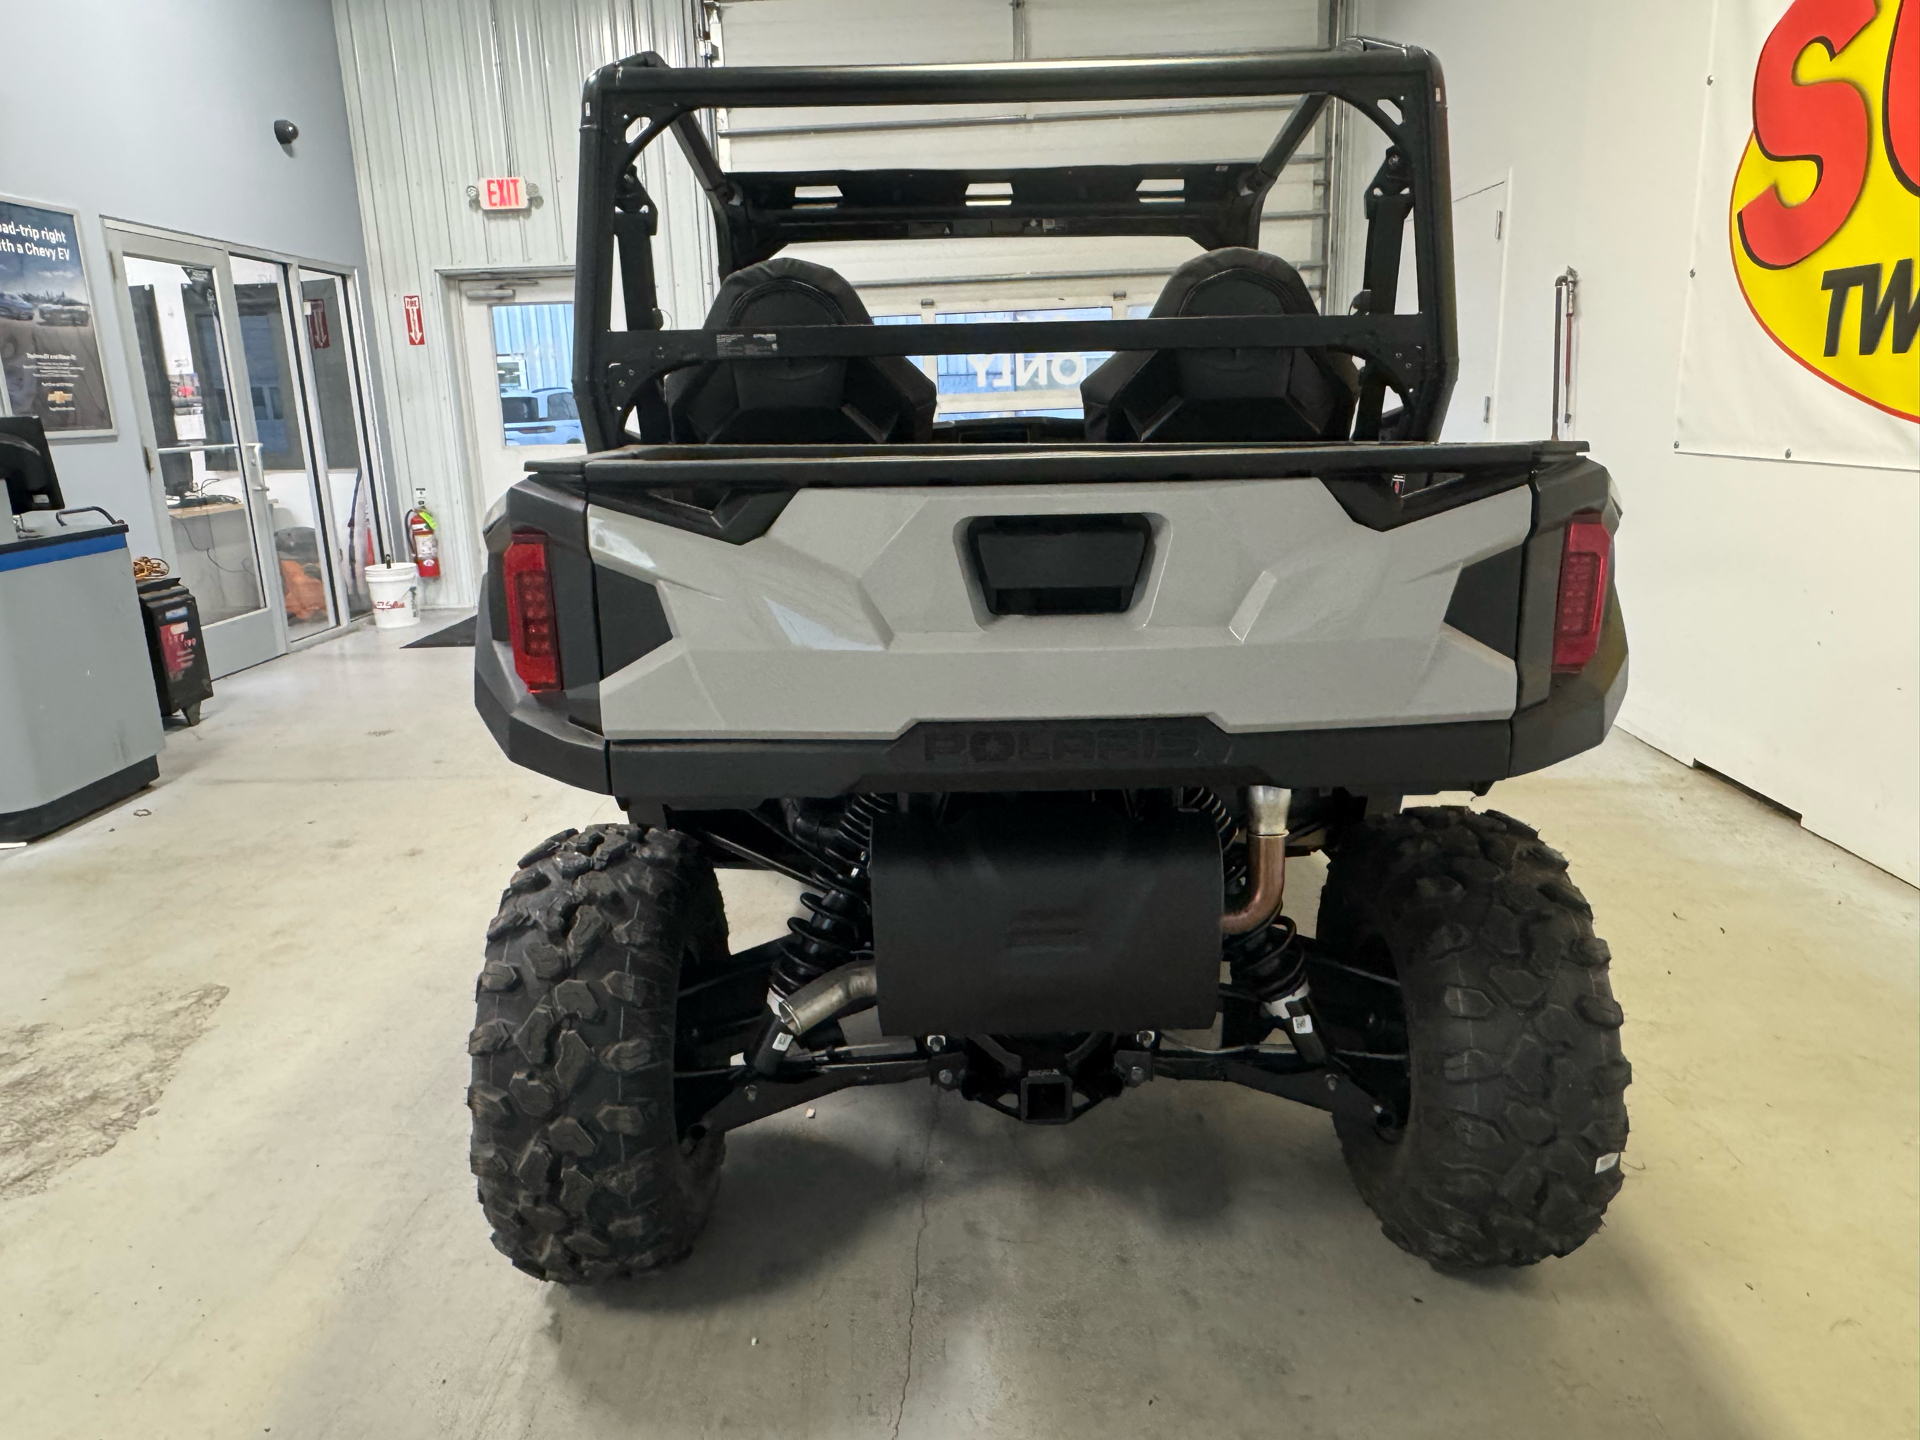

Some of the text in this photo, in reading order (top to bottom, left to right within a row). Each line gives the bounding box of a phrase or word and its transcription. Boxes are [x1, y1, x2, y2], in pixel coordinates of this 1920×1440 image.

[486, 178, 519, 207] EXIT
[41, 226, 67, 244] right
[17, 243, 24, 254] a
[25, 242, 56, 261] Chevy
[57, 247, 70, 261] EV
[925, 728, 1199, 763] POLARIS
